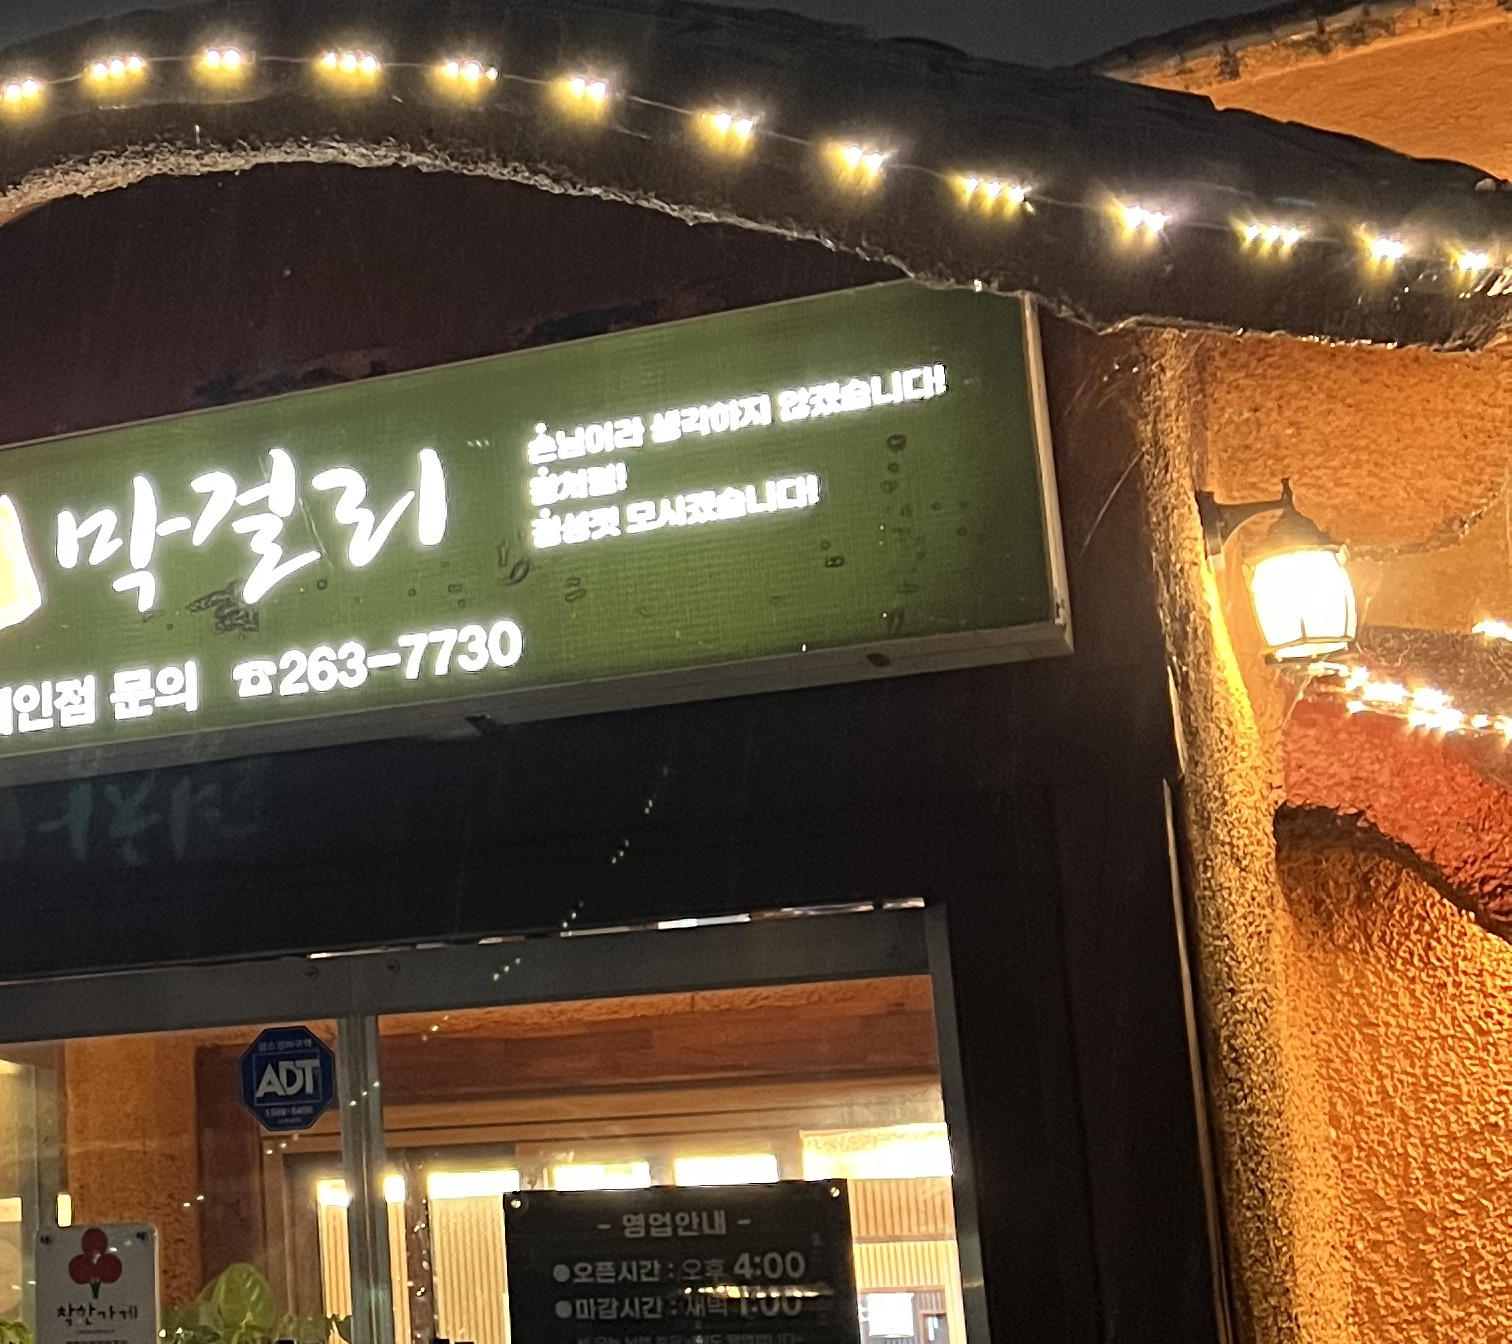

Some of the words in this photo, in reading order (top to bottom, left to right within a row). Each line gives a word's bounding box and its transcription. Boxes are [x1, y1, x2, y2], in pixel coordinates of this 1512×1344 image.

[528, 419, 645, 464] 손님이라
[57, 449, 448, 612] 막걸리
[110, 661, 198, 720] 문의
[281, 621, 523, 698] 263-7730
[255, 1059, 321, 1098] ADT
[621, 1209, 727, 1239] 영업안내
[572, 1258, 662, 1285] 오픈시간
[681, 1259, 725, 1284] 오후
[732, 1251, 806, 1280] 4:00
[57, 1301, 138, 1327] 착한가게
[573, 1295, 663, 1322] 마감시간
